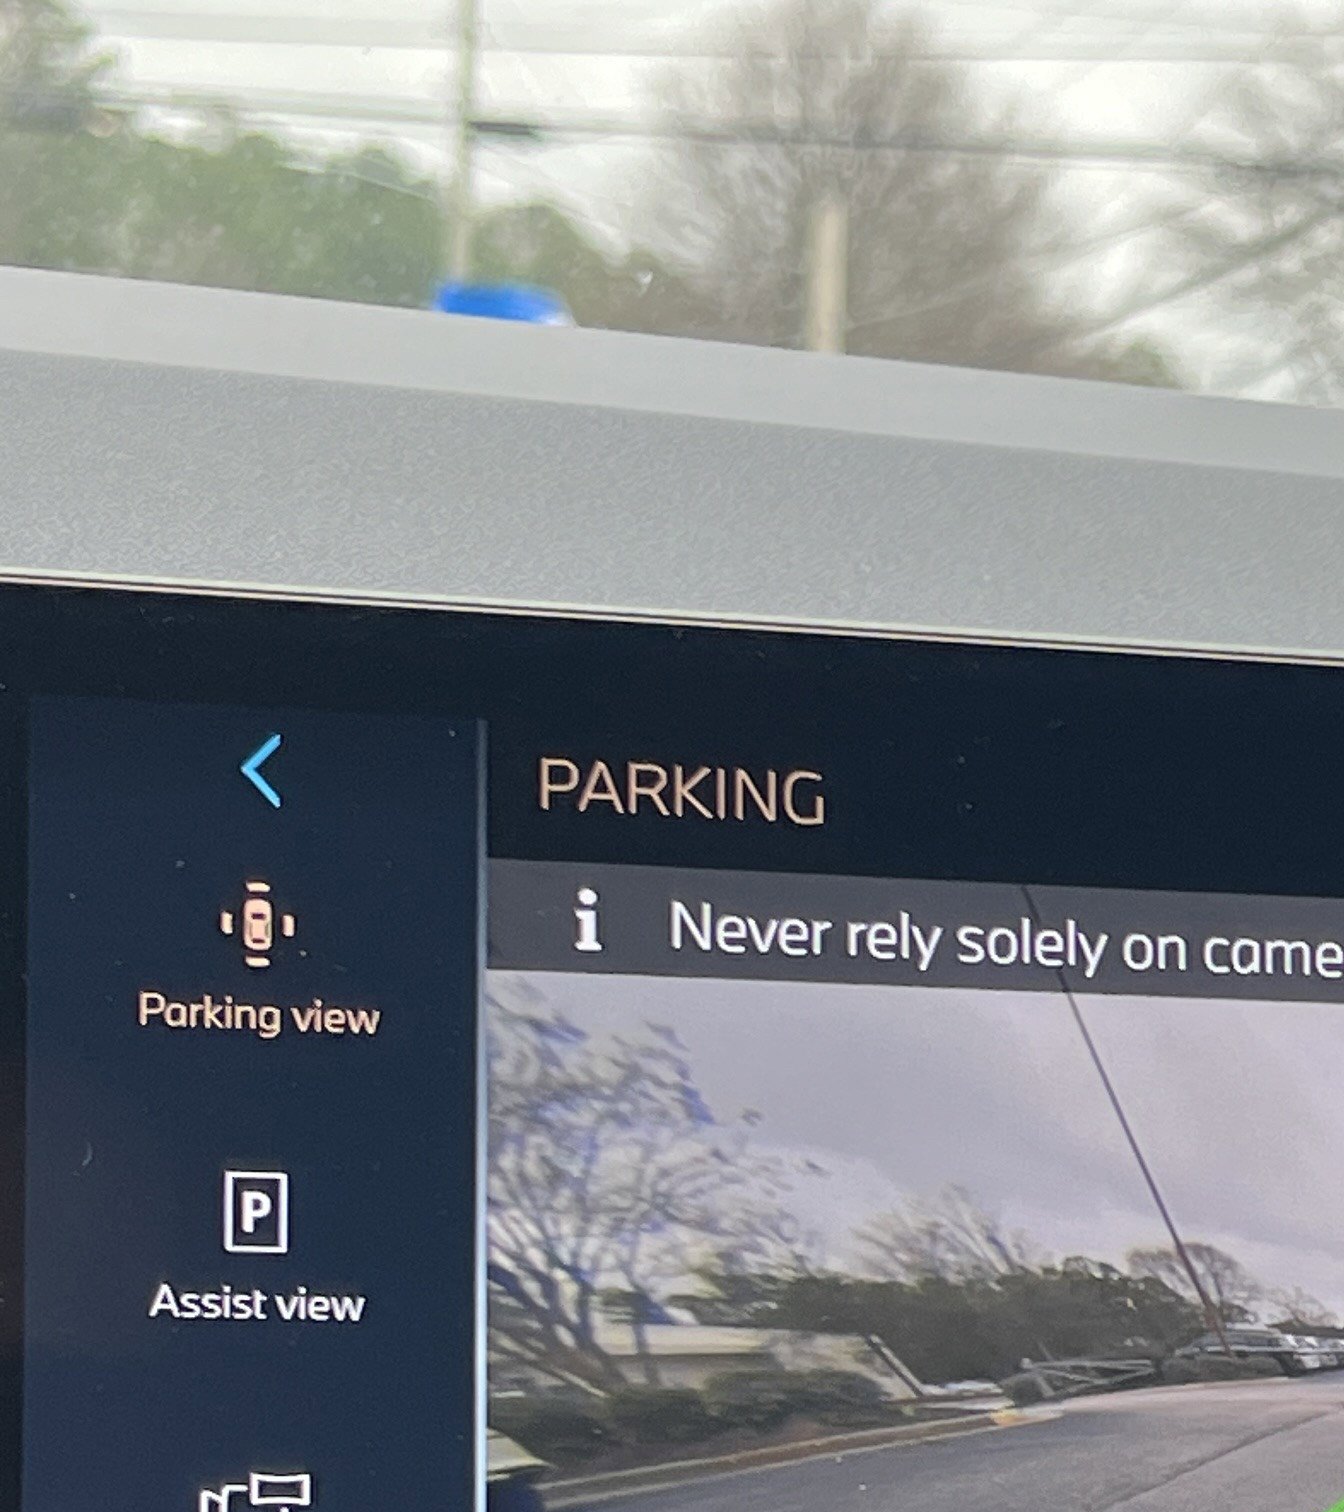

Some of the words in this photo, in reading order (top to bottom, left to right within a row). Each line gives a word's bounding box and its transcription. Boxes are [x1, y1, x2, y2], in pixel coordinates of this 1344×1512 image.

[541, 757, 824, 825] PARKING
[671, 900, 833, 956] Never
[848, 911, 943, 971] rely
[957, 917, 1109, 978] solely
[1123, 933, 1187, 971] on
[139, 991, 281, 1038] Parking
[290, 999, 380, 1035] view
[149, 1283, 268, 1320] Assist
[274, 1286, 366, 1322] view
